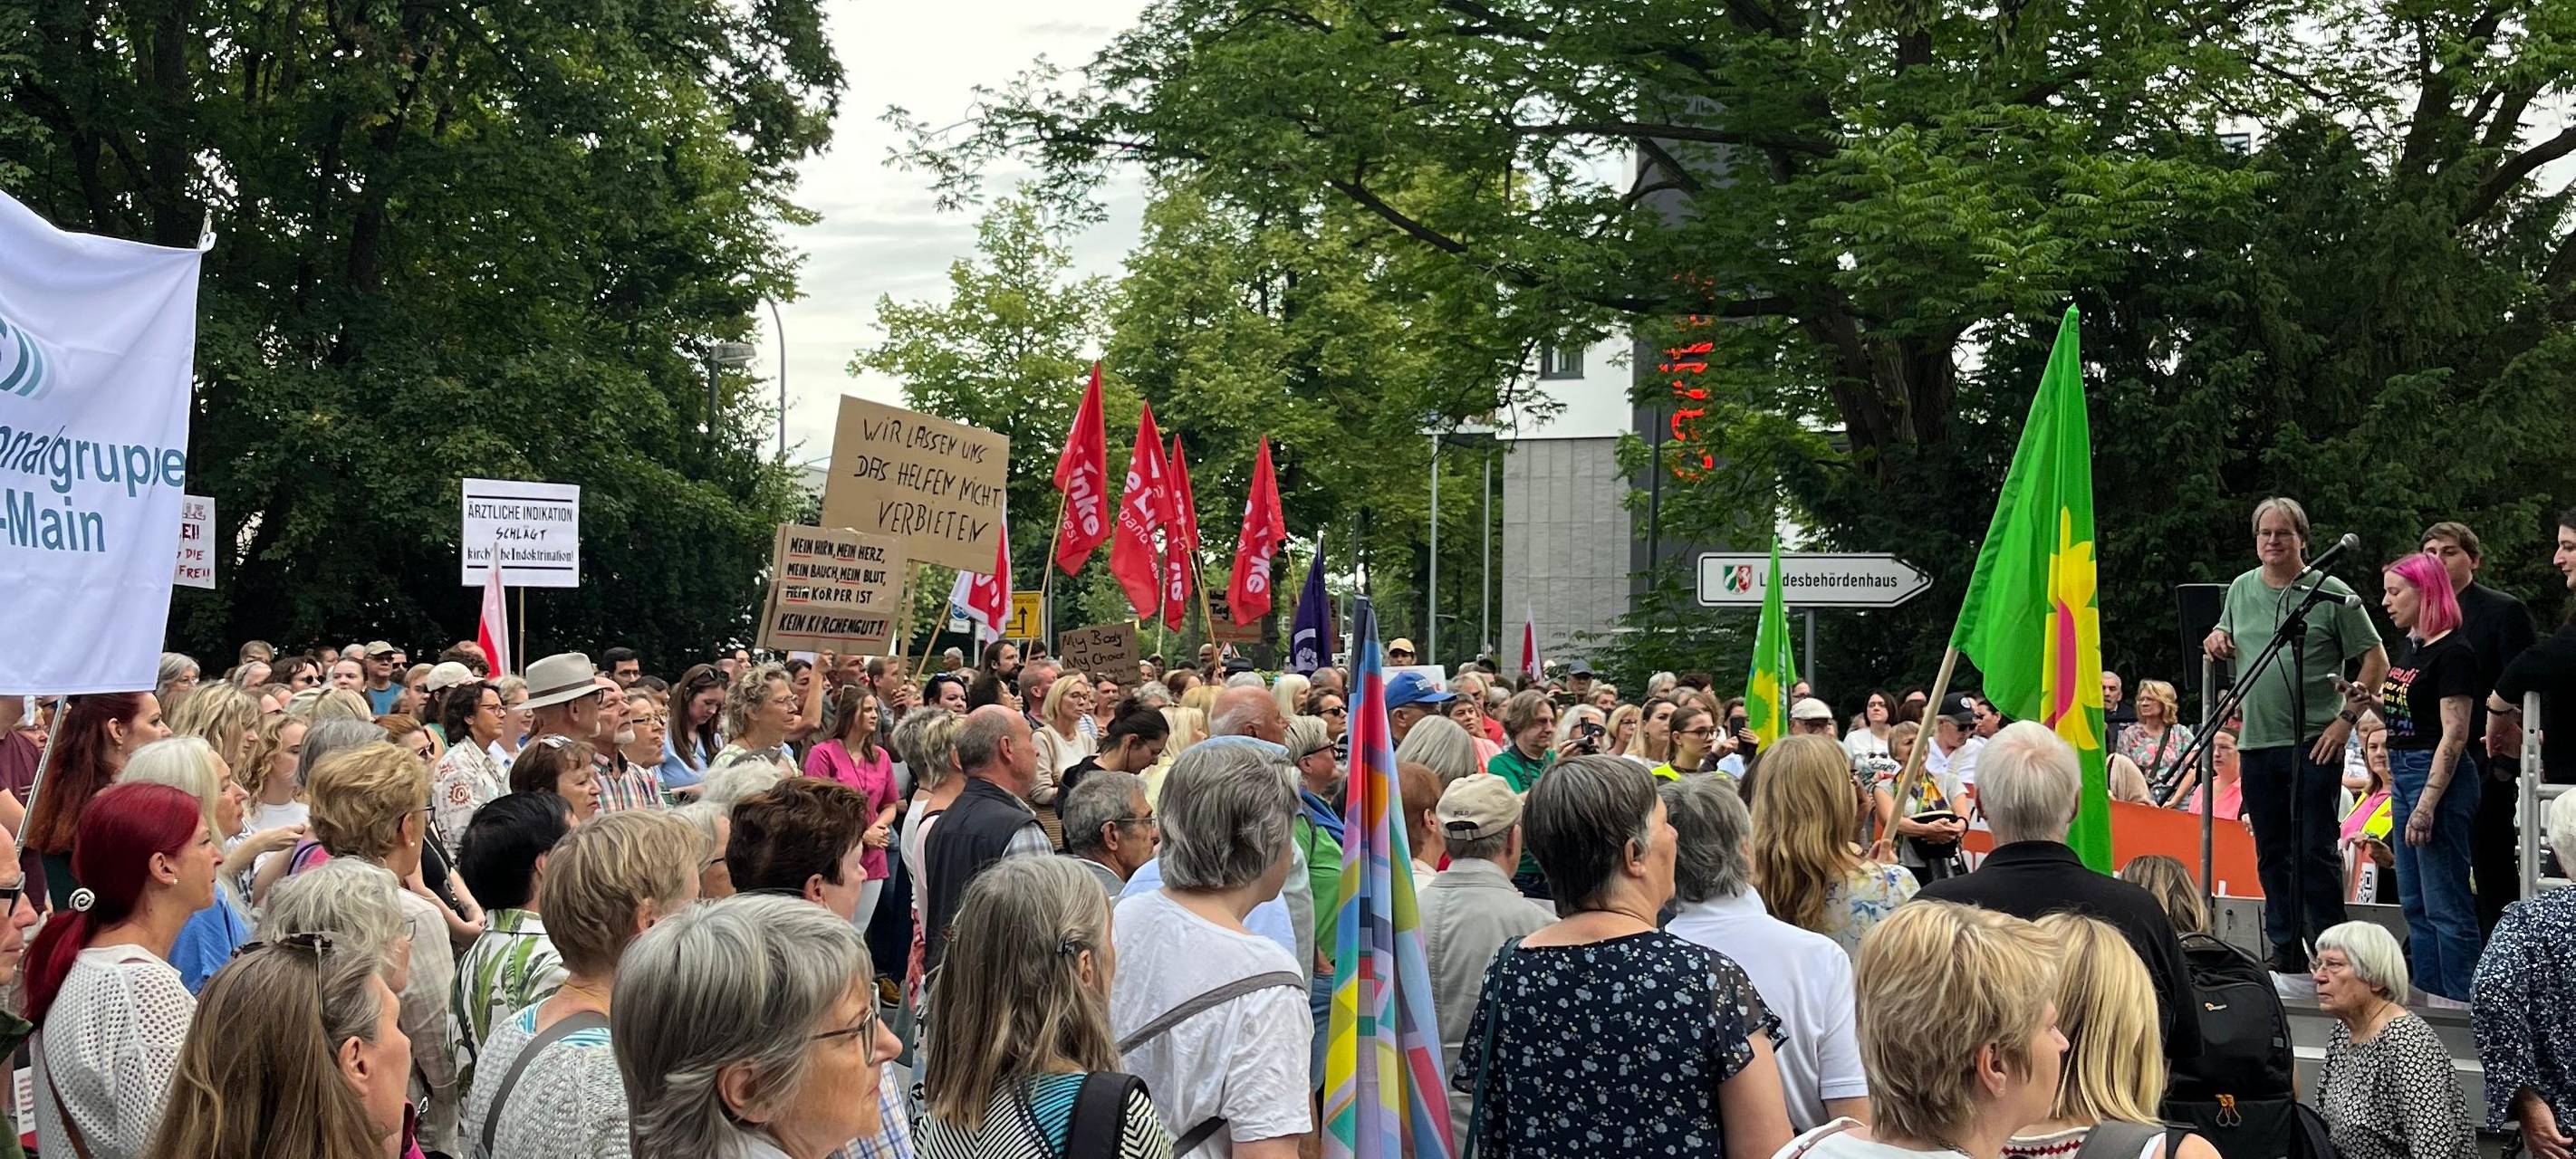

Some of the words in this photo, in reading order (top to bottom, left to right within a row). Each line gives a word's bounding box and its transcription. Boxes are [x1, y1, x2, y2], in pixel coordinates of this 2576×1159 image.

[907, 426, 957, 456] LASSEN
[962, 441, 989, 464] UNS
[854, 455, 891, 481] DAS
[898, 462, 956, 495] HELFEN
[468, 501, 520, 522] ÄRZTLICHE
[523, 505, 573, 522] INDIKATION
[495, 525, 547, 541] SCHLÄGT
[790, 537, 812, 554] MEIN
[836, 543, 856, 559] MEIN
[858, 545, 885, 564] HERZ,
[787, 562, 809, 578] MEIN
[810, 565, 839, 583] BAUCH,
[840, 567, 860, 582] MEIN
[863, 570, 886, 586] BLUT,
[1759, 571, 1898, 587] Ldesbehördenhaus
[785, 585, 809, 599] MEIN
[811, 587, 851, 604] KÖRPER
[778, 613, 805, 632] KEIN
[1062, 634, 1088, 653] My
[1066, 658, 1091, 672] My
